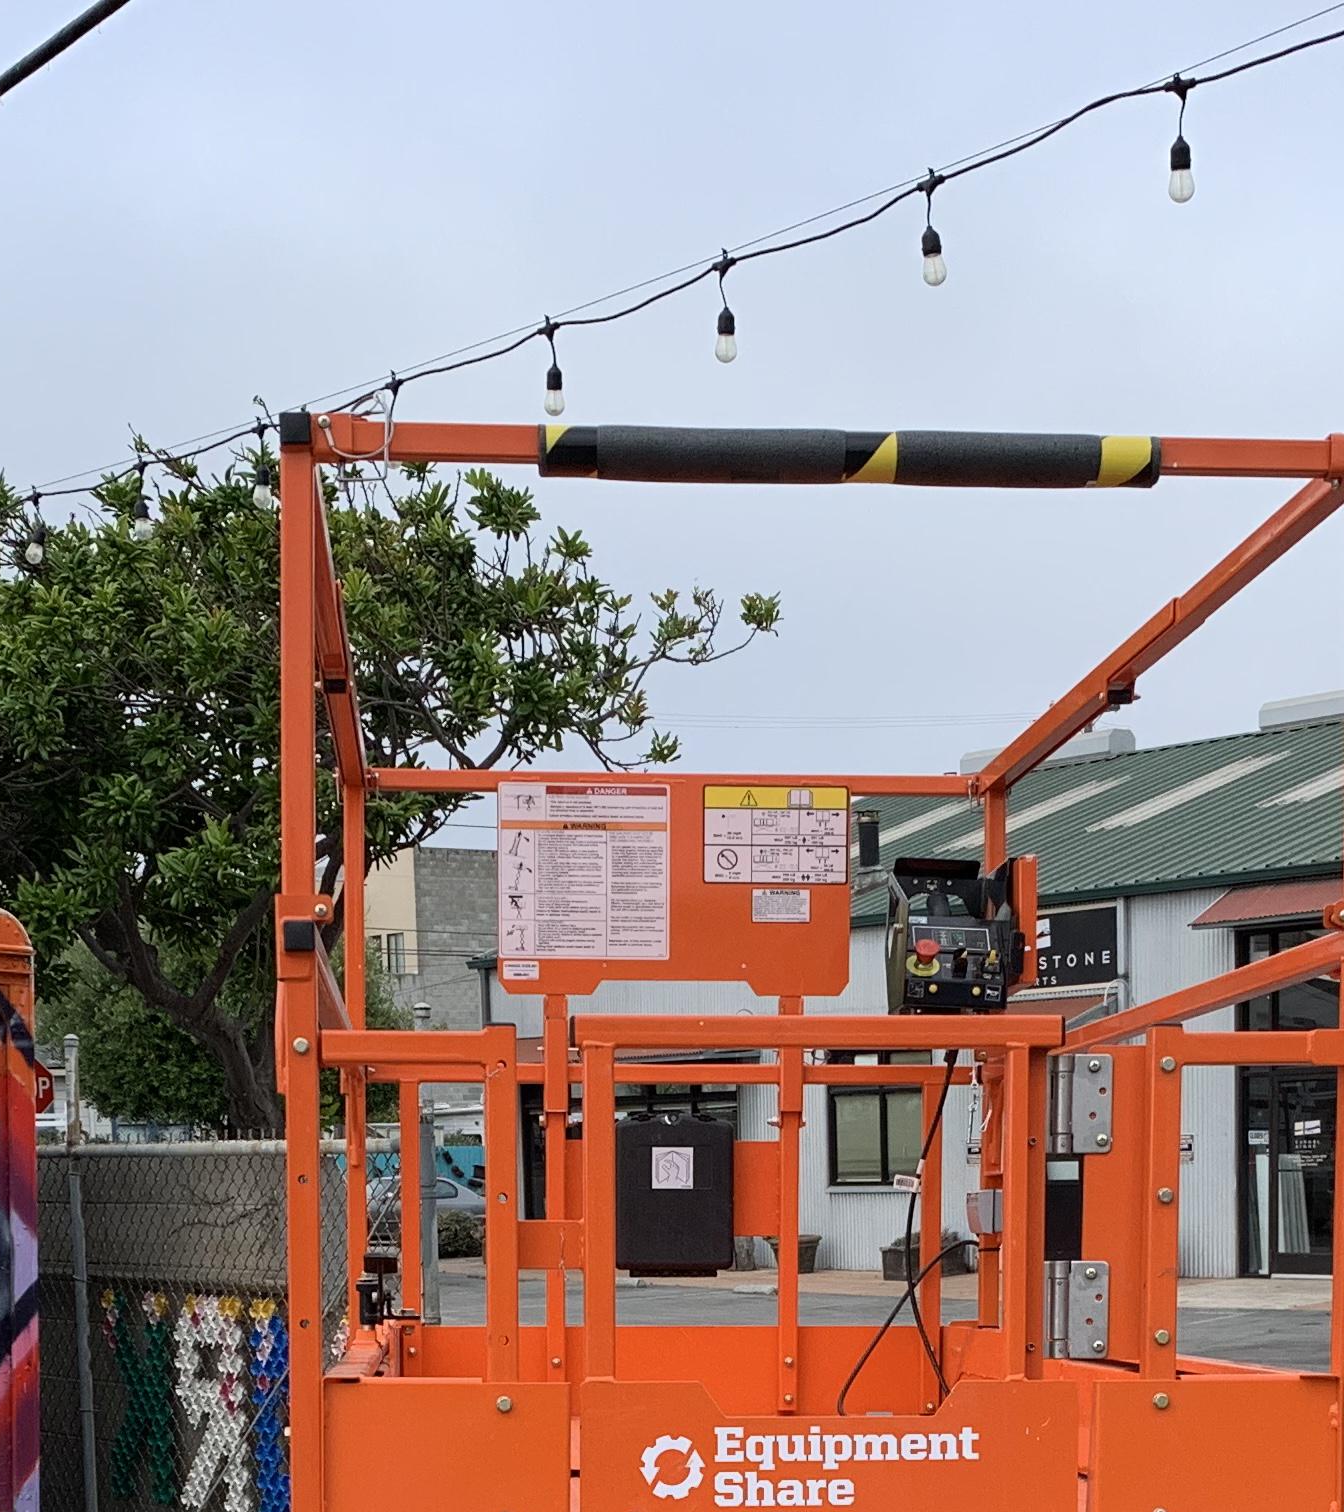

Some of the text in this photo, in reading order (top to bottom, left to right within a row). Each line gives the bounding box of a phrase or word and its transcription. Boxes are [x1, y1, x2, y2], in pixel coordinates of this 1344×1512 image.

[594, 787, 627, 795] DANGER
[1038, 950, 1111, 970] STONE
[714, 1426, 980, 1470] Equipment
[714, 1471, 855, 1507] Share
